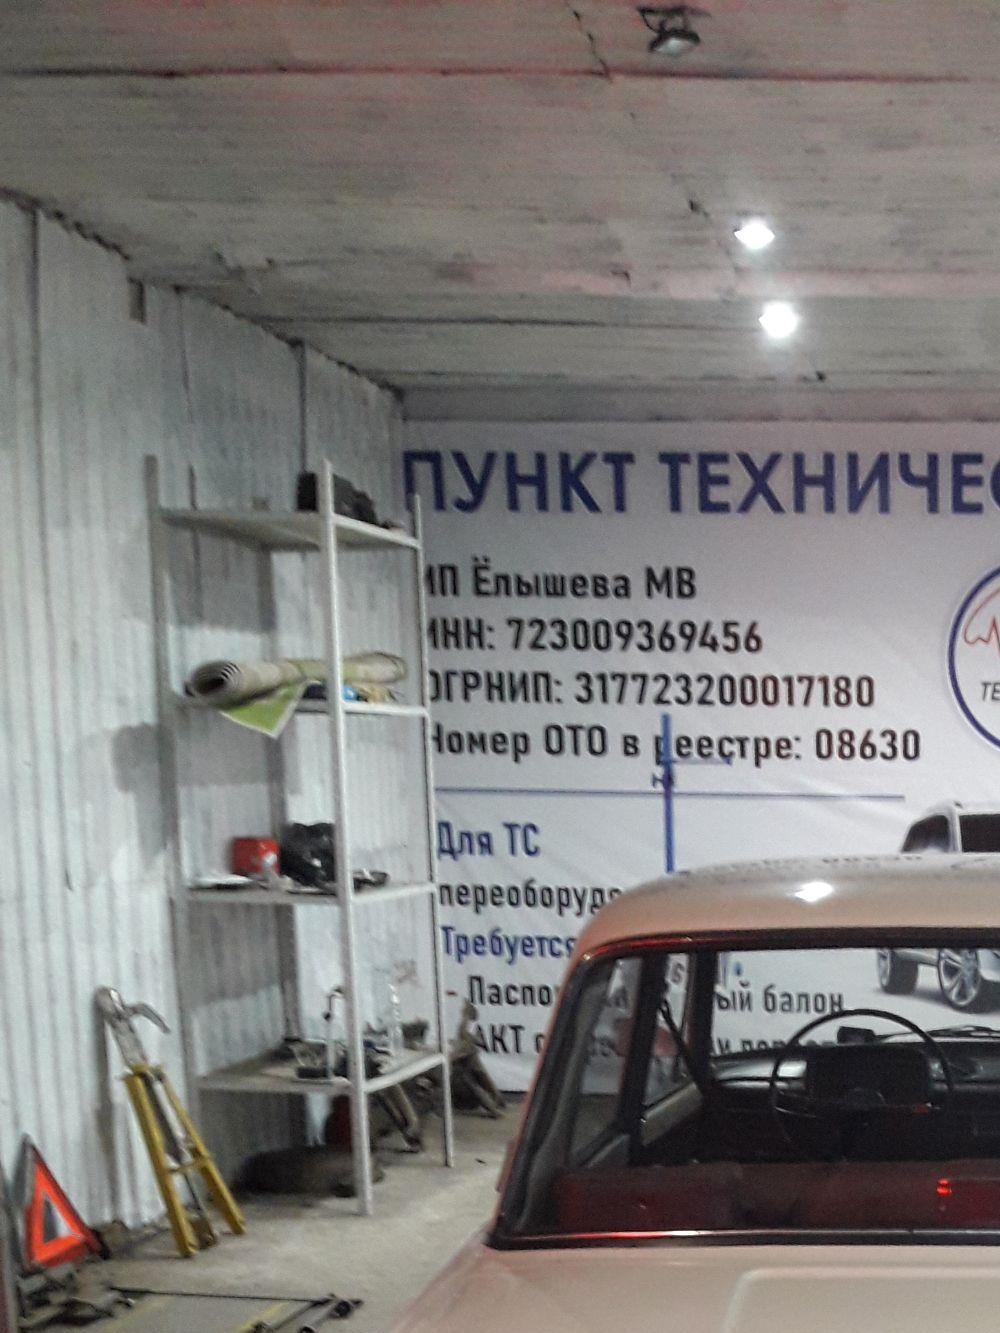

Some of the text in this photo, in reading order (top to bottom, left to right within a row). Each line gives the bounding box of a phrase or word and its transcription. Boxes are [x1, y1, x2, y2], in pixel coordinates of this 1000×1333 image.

[403, 451, 635, 513] ПУНКТ
[473, 555, 631, 599] Ёлышева
[645, 566, 697, 600] МВ
[507, 617, 763, 653] 723009369456
[574, 672, 875, 707] 317723200017180
[545, 724, 607, 756] ОТО
[815, 728, 920, 761] 08630
[438, 821, 541, 861] Для ТС
[469, 976, 560, 1008] Паспо
[764, 982, 846, 1014] балон
